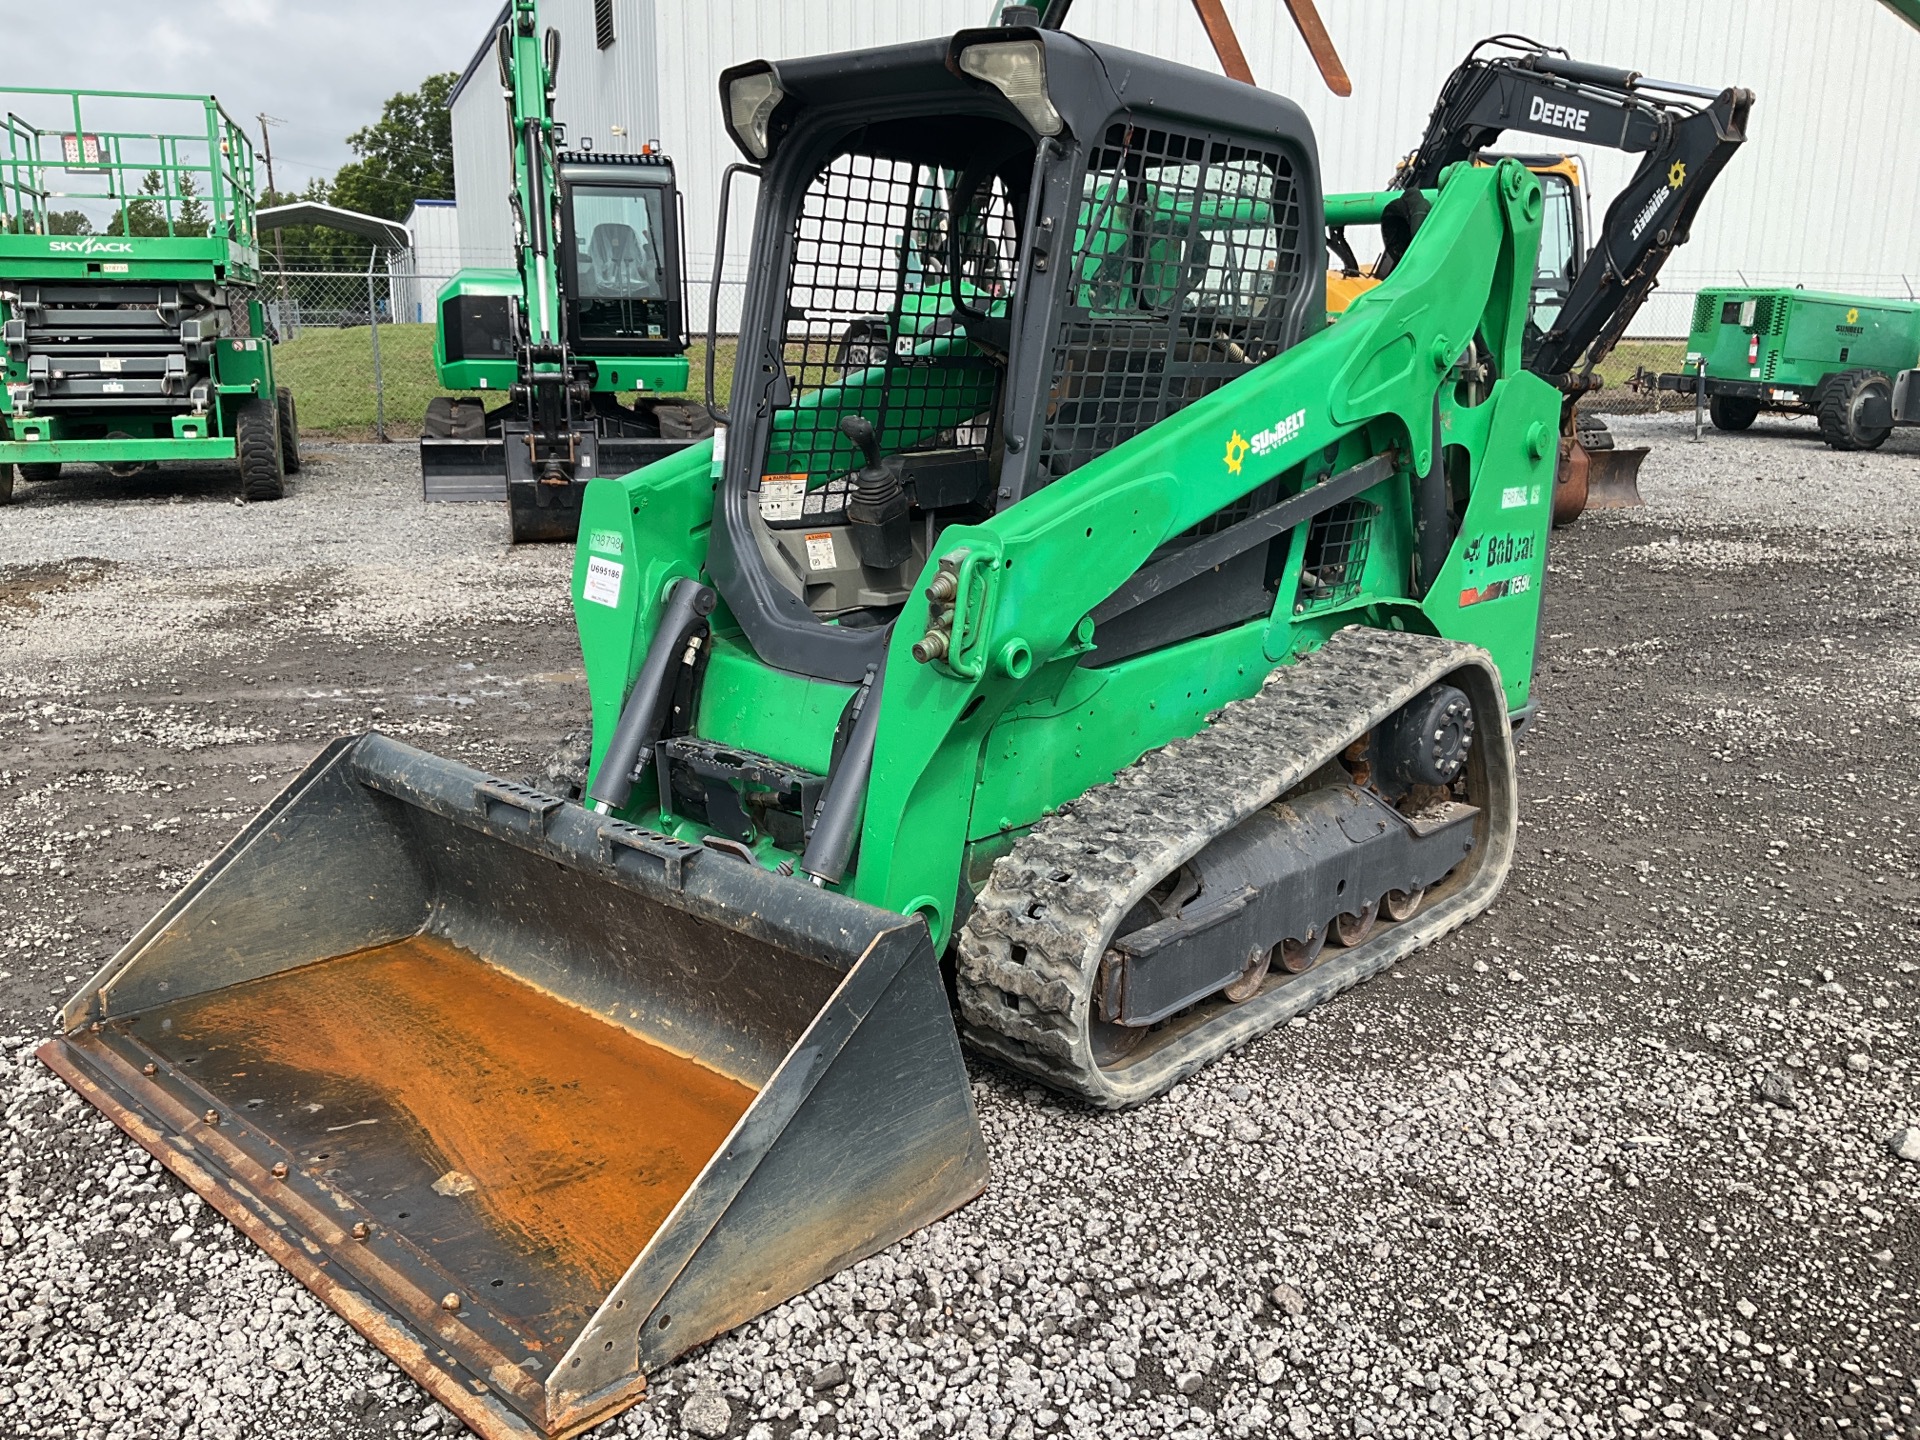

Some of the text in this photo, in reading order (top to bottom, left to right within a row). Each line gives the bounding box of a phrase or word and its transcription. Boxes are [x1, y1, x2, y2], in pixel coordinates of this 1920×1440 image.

[1529, 96, 1590, 131] DEERE
[1629, 185, 1670, 241] SUNBELT
[49, 237, 134, 255] SKYJACK
[1835, 325, 1864, 335] SUNBELT
[1250, 407, 1306, 454] SUNBELT
[1486, 529, 1535, 567] Bobcat
[590, 563, 620, 579] U695186
